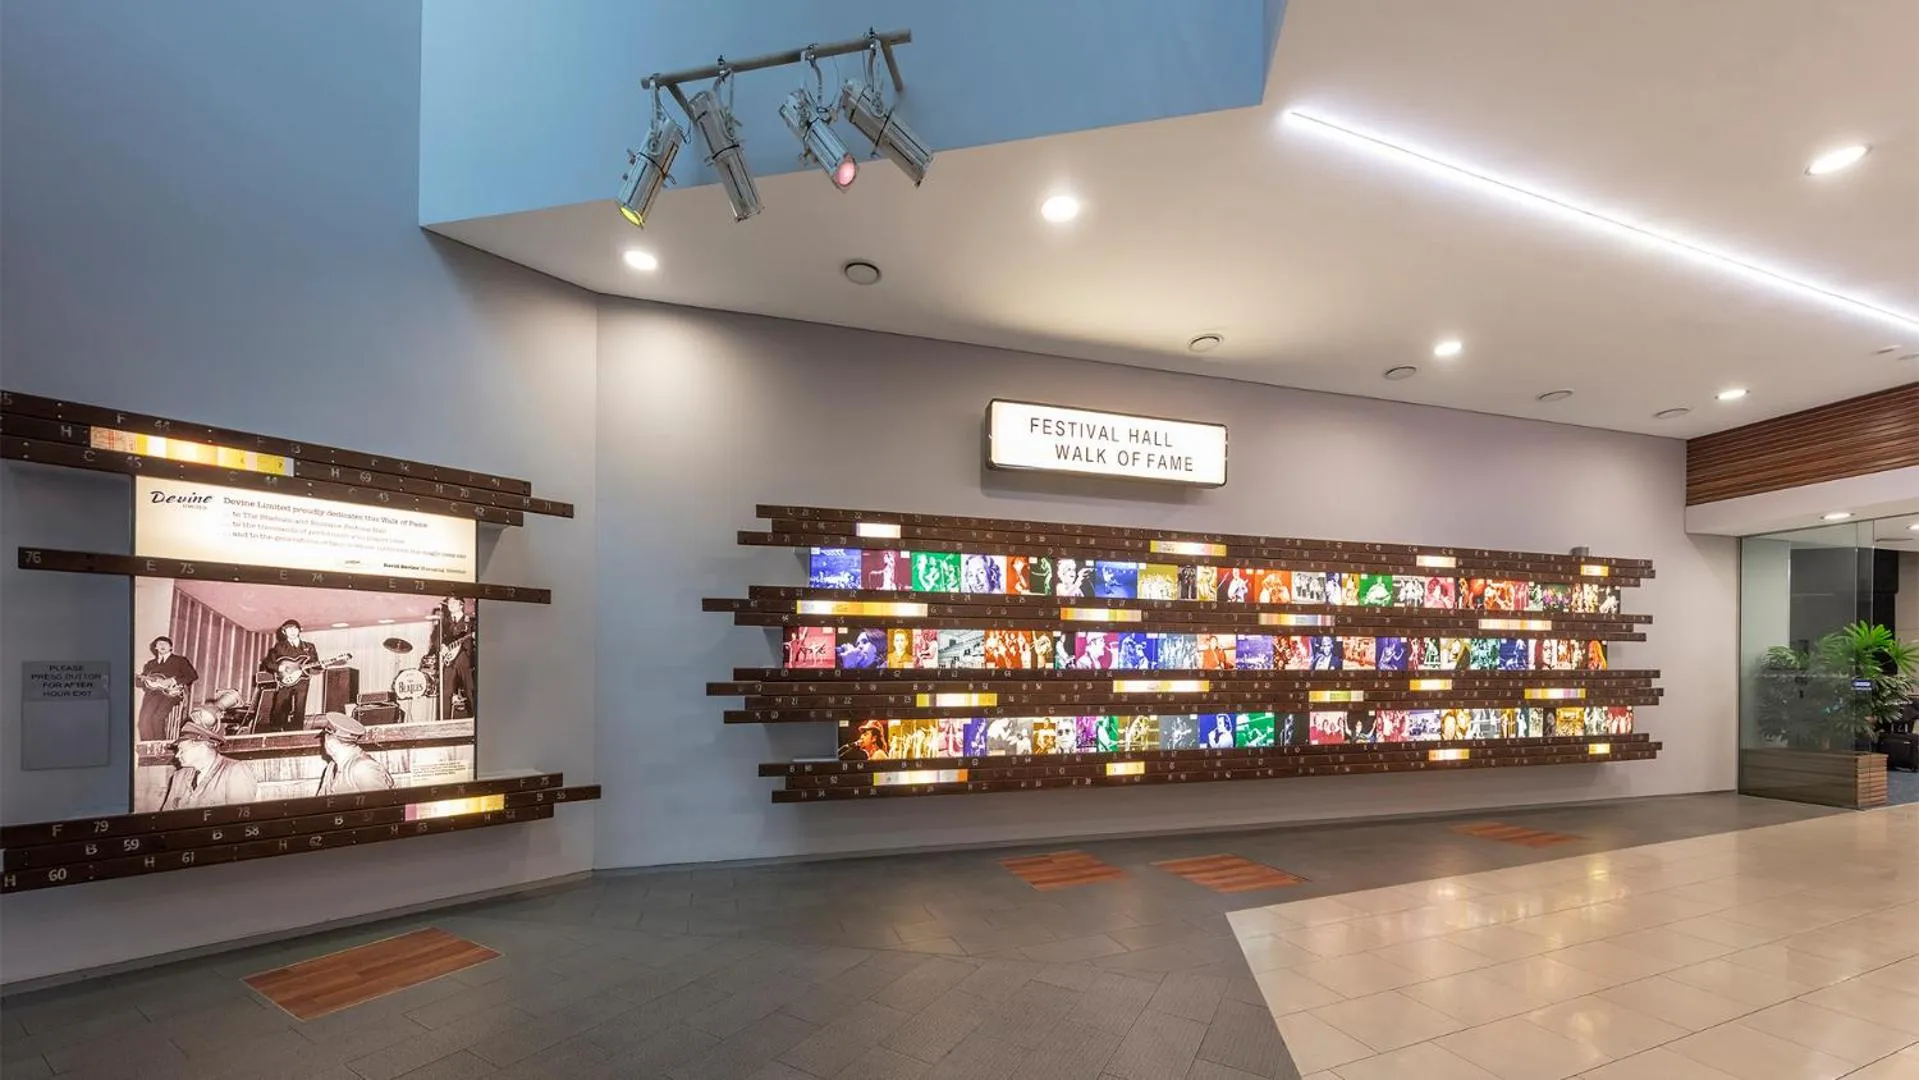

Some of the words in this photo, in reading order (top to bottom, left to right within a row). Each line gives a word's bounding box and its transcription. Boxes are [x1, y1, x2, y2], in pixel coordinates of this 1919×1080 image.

[59, 425, 73, 438] H
[1029, 416, 1120, 443] FESTIVAL
[1128, 428, 1173, 448] HALL
[1054, 443, 1107, 465] WALK
[1117, 450, 1141, 467] OF
[1146, 453, 1194, 473] FAME
[150, 490, 216, 505] Devine
[223, 497, 256, 509] Devine
[256, 502, 292, 514] Limited
[292, 507, 325, 517] proudly
[145, 560, 158, 572] E
[179, 561, 196, 575] 75
[48, 664, 85, 672] PLEASE
[30, 672, 63, 681] PRESS
[64, 672, 102, 682] BUTTON
[42, 680, 62, 690] FOR
[62, 680, 94, 690] AFTER
[42, 690, 71, 698] HOUR
[72, 690, 93, 698] EXIT
[51, 823, 64, 838] F
[93, 819, 110, 833] 79
[203, 809, 213, 822] F
[84, 843, 99, 856] B
[123, 838, 141, 852] 59
[243, 824, 260, 838] 58
[3, 874, 17, 888] H
[47, 867, 68, 882] 60
[143, 855, 156, 868] H
[181, 850, 196, 865] 61
